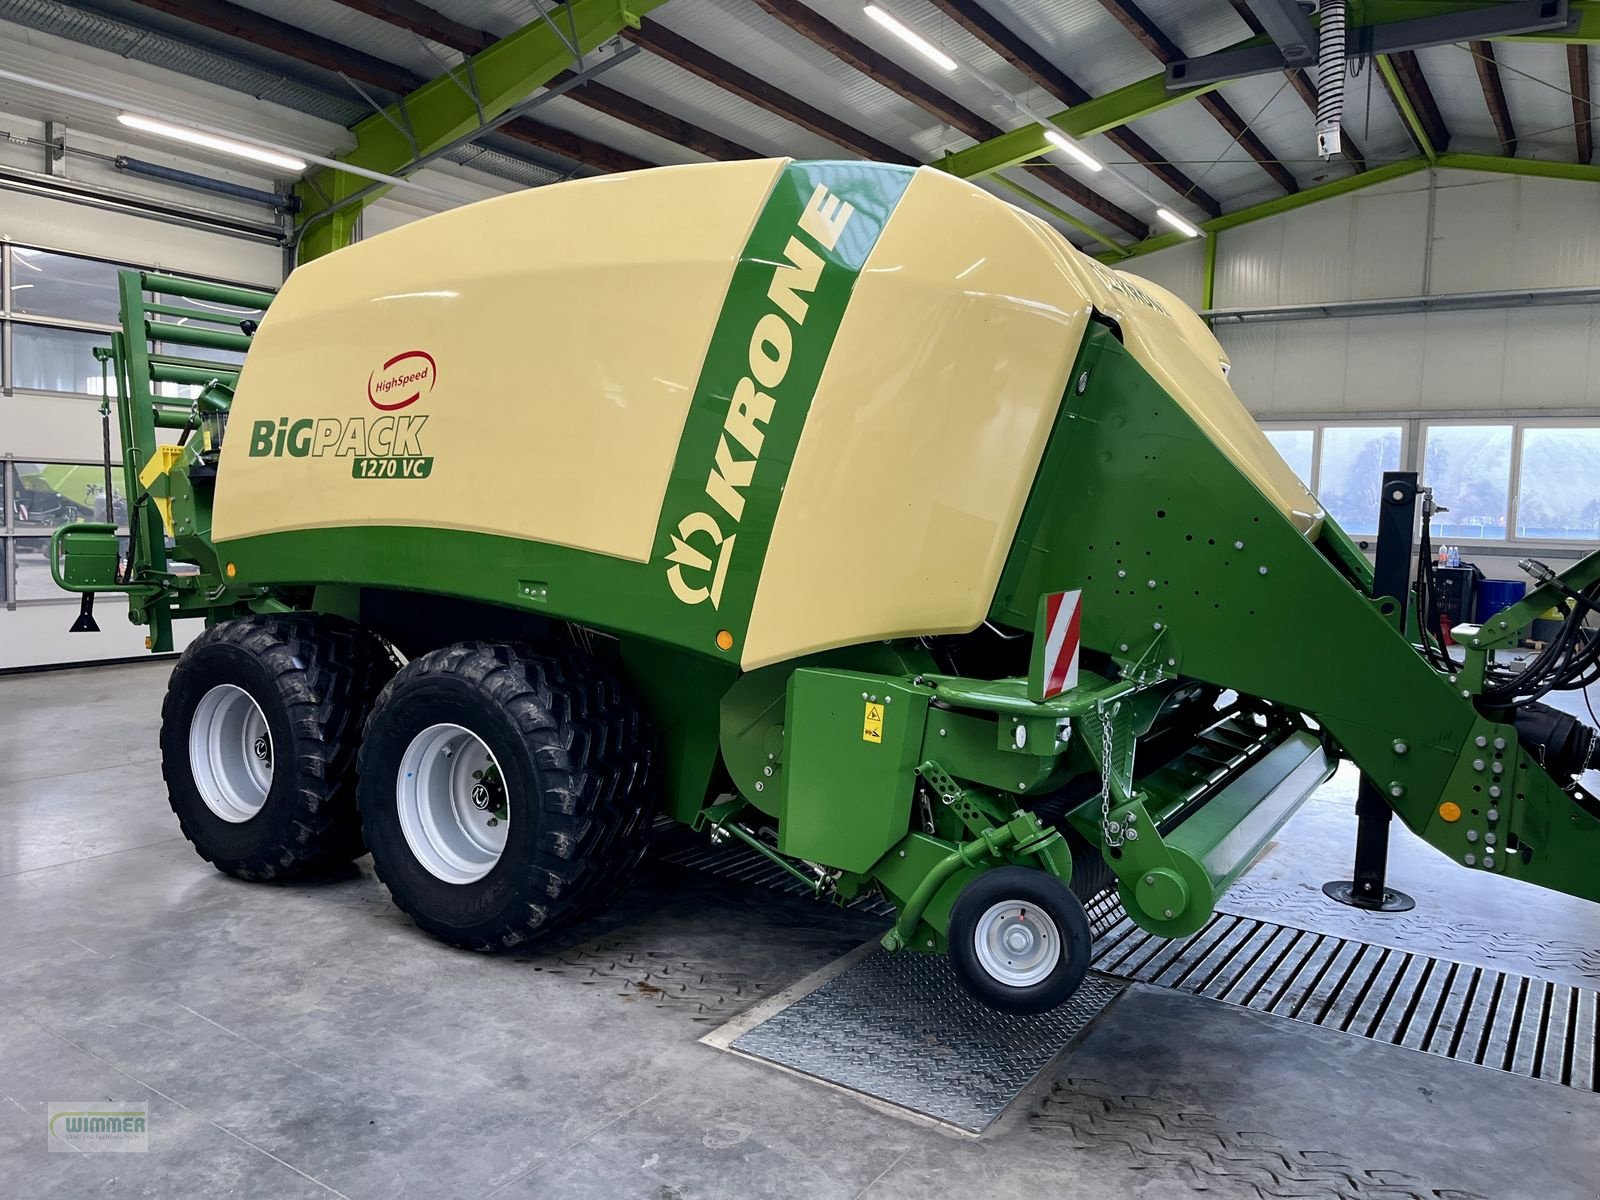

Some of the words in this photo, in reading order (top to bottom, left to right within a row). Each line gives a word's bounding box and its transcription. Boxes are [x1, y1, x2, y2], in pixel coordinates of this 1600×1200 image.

[705, 183, 855, 523] KRONE
[375, 367, 428, 393] HighSpeed
[360, 459, 397, 477] 1270
[402, 459, 424, 477] VC
